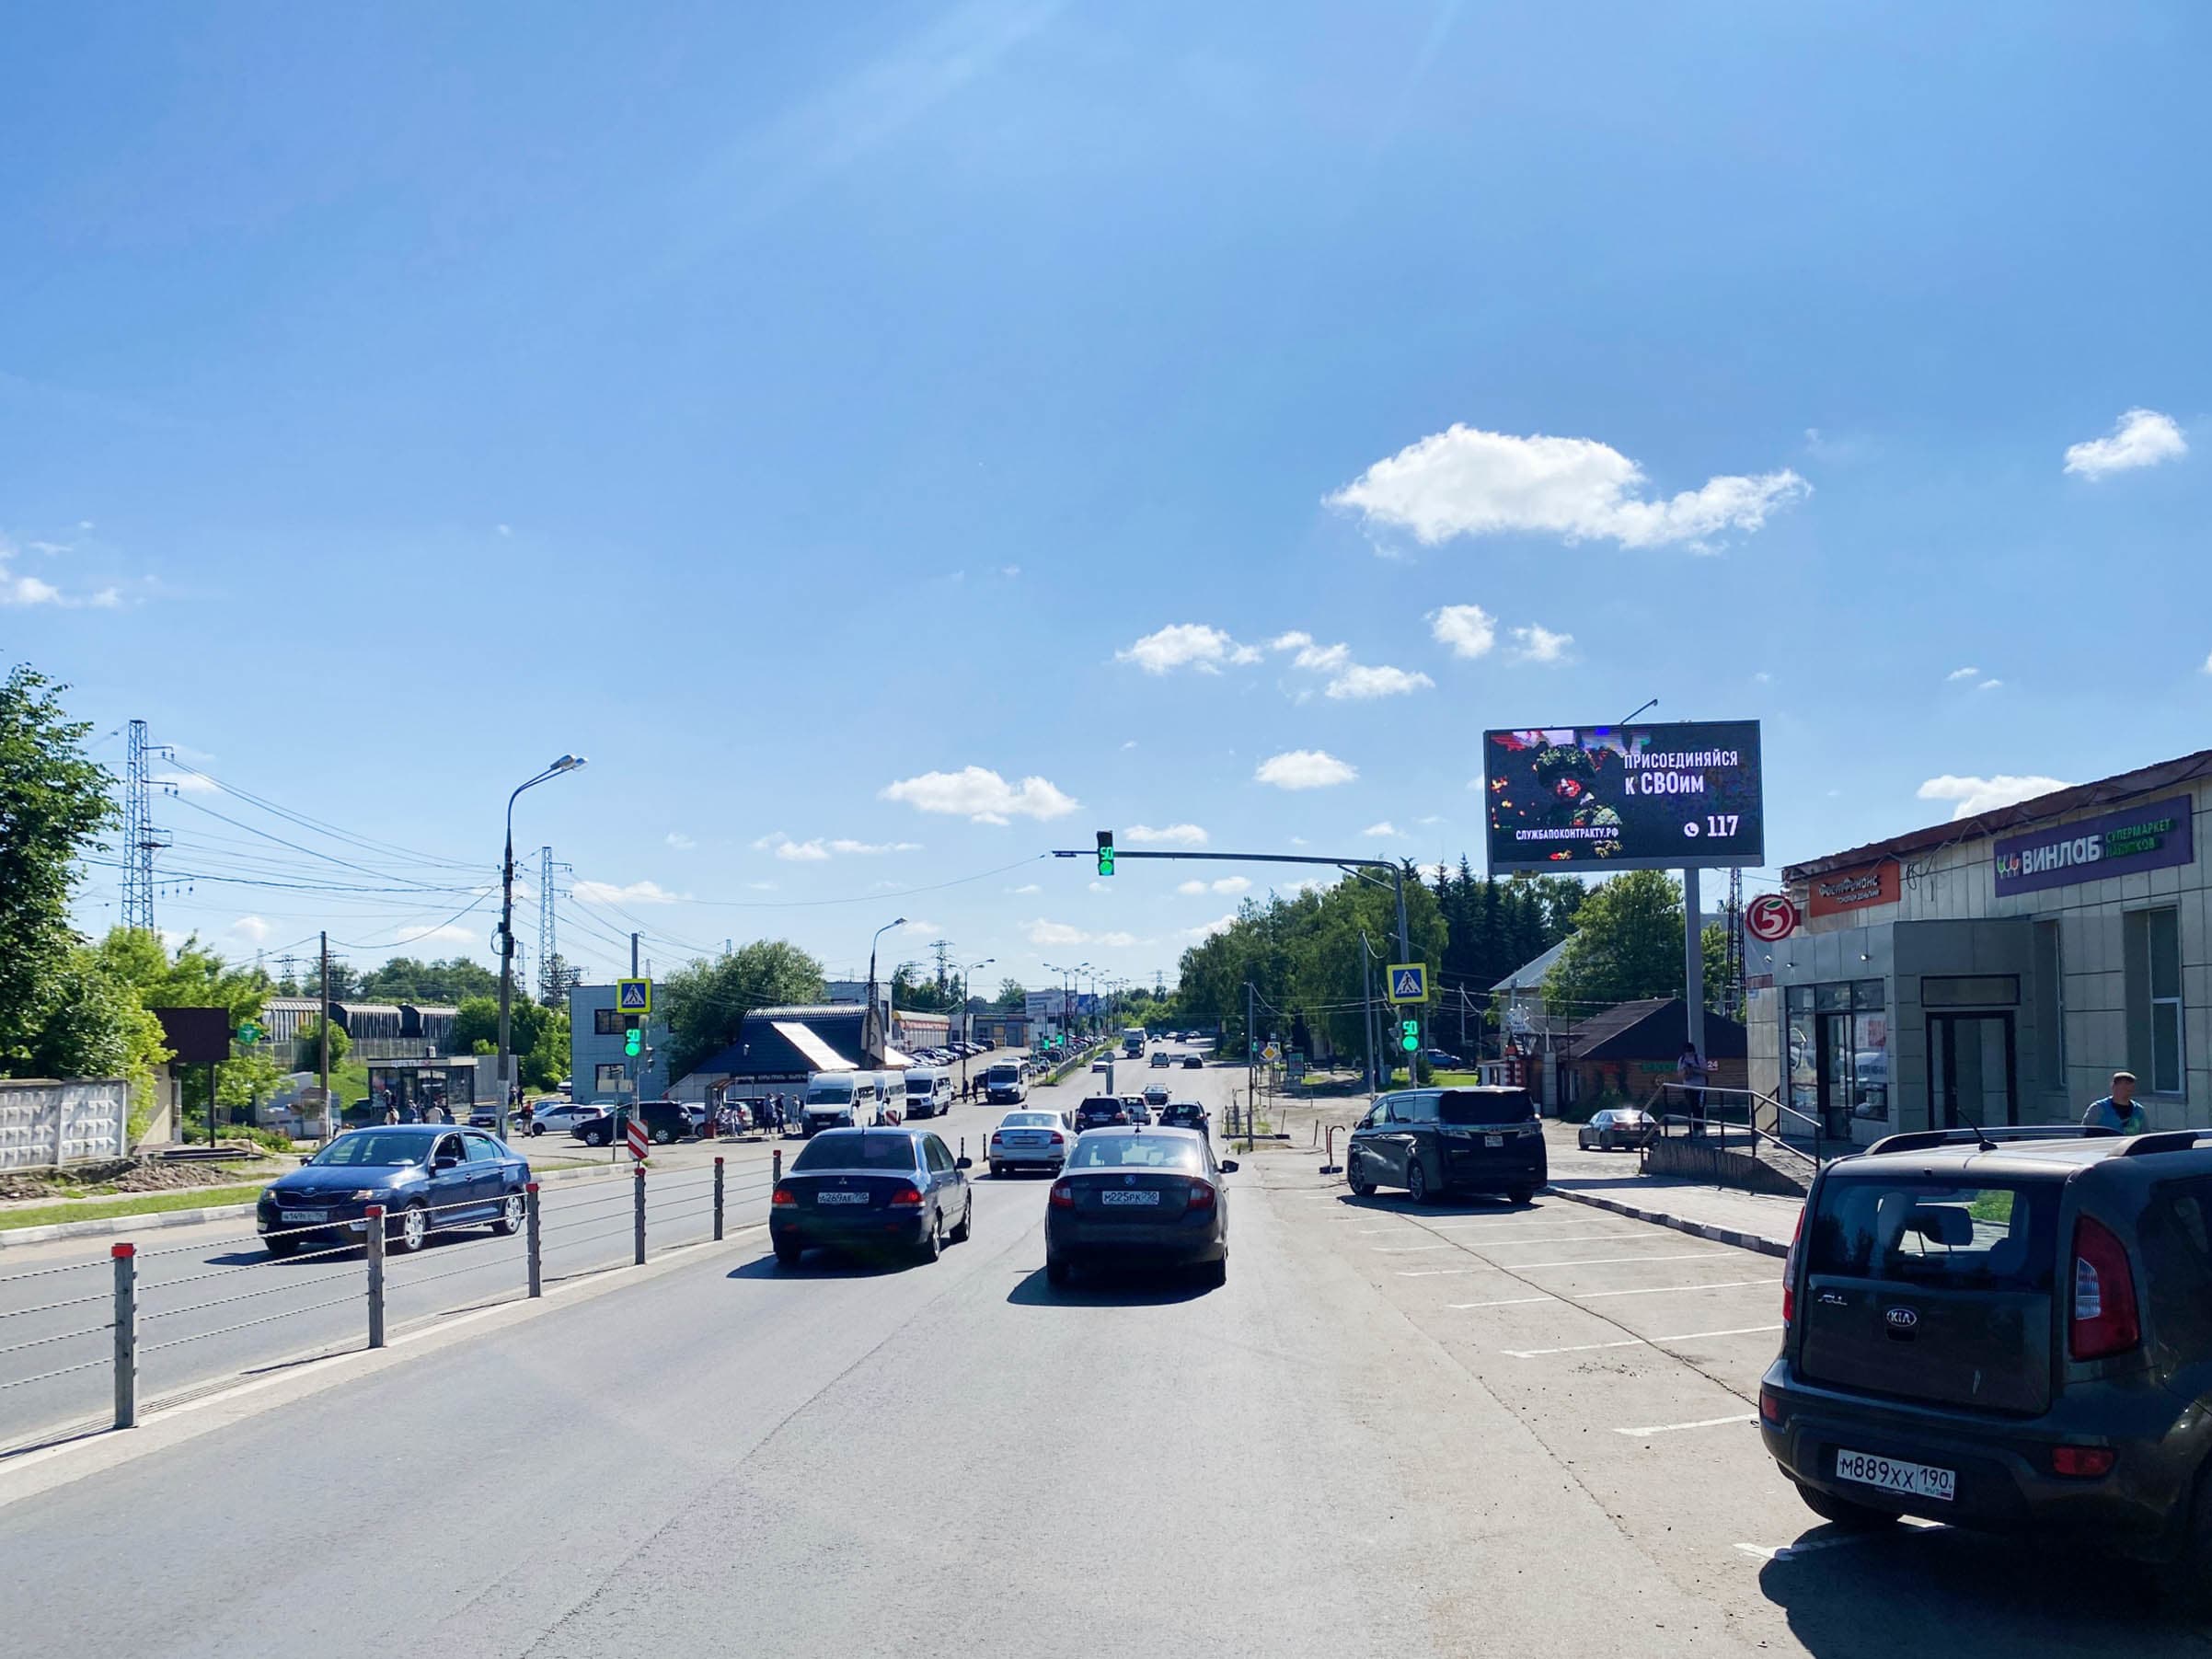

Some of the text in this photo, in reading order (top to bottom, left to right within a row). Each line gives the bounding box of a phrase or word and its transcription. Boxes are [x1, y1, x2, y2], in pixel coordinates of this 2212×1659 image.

[1624, 750, 1738, 769] ПРИСОЕДИНЯЙСЯ
[1515, 827, 1619, 840] СЛУЖБАПОКОНТРАКТУ.РФ
[1707, 815, 1739, 837] 117
[2104, 818, 2172, 843] СУПЕРМАРКЕТ
[2022, 834, 2103, 875] ВИНЛАБ
[1891, 1311, 1911, 1324] KIA
